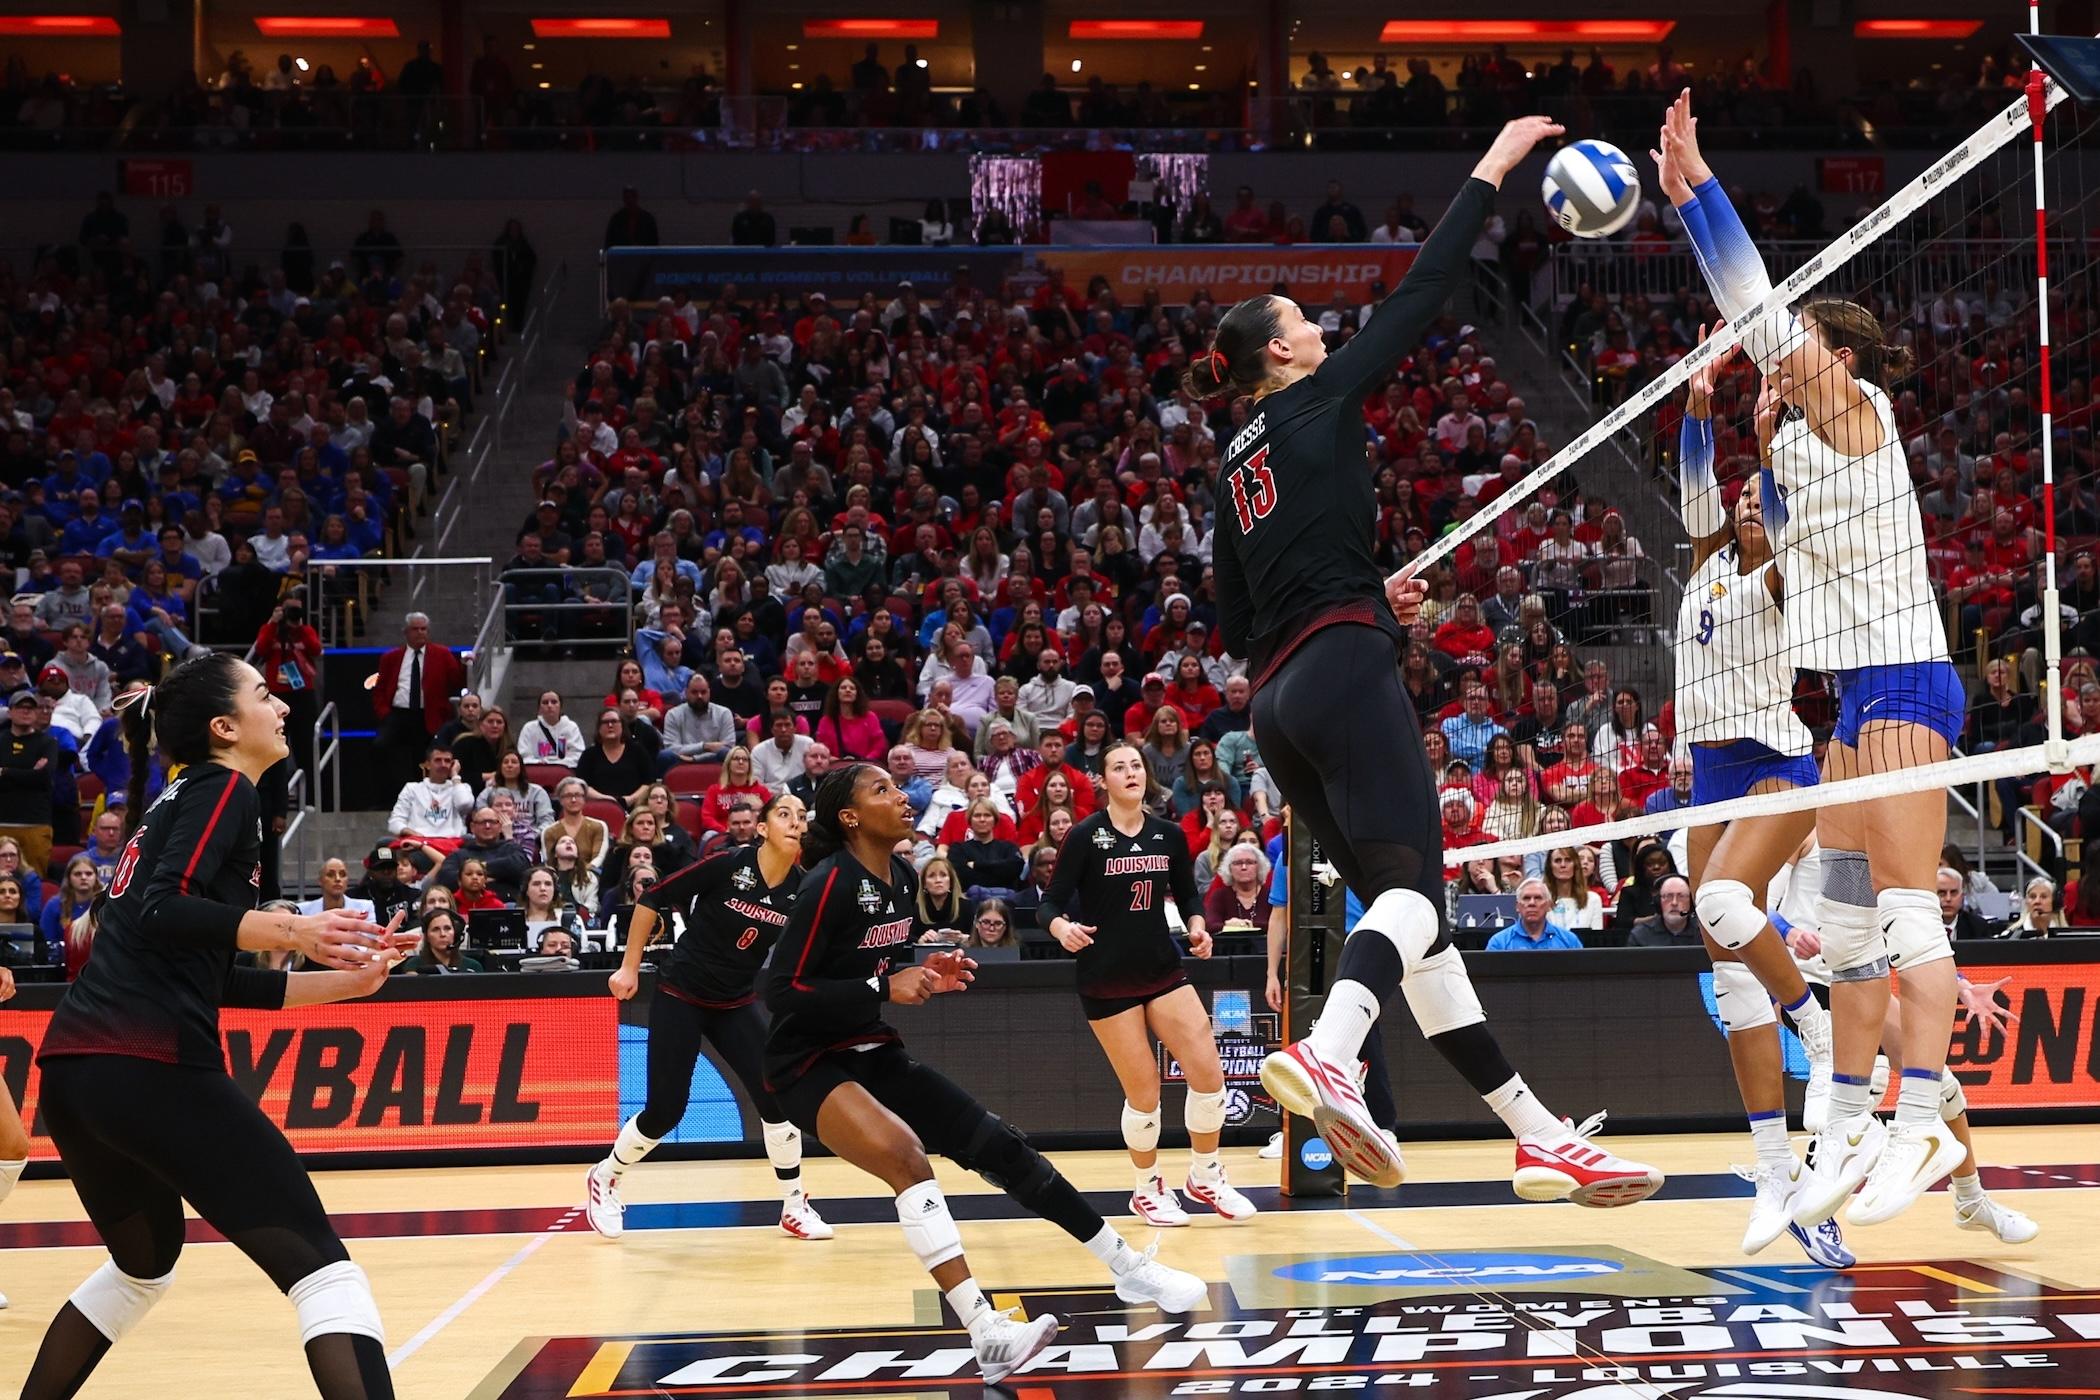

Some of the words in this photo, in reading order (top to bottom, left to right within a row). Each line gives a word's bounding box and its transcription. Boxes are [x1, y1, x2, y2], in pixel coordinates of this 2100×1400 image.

[147, 173, 186, 198] 115
[1845, 170, 1881, 193] 117
[760, 271, 841, 283] WOMEN'S
[845, 270, 952, 283] VOLLEYBALL
[1120, 264, 1382, 284] CHAMPIONSHIP
[1227, 442, 1278, 535] 13
[1696, 609, 1715, 646] 9
[1104, 854, 1170, 876] LOUISVILLE
[1129, 879, 1153, 912] 21
[736, 926, 759, 950] 8
[1304, 1152, 1332, 1163] NCAA
[1319, 1262, 1621, 1282] NCAA
[1284, 1308, 1364, 1318] DI
[1401, 1297, 1729, 1314] WOMEN'S
[1094, 1301, 1970, 1342] VOLLEYBALL
[1170, 1372, 1440, 1396] 2024
[1532, 1353, 2059, 1382] LOUISVILLE
